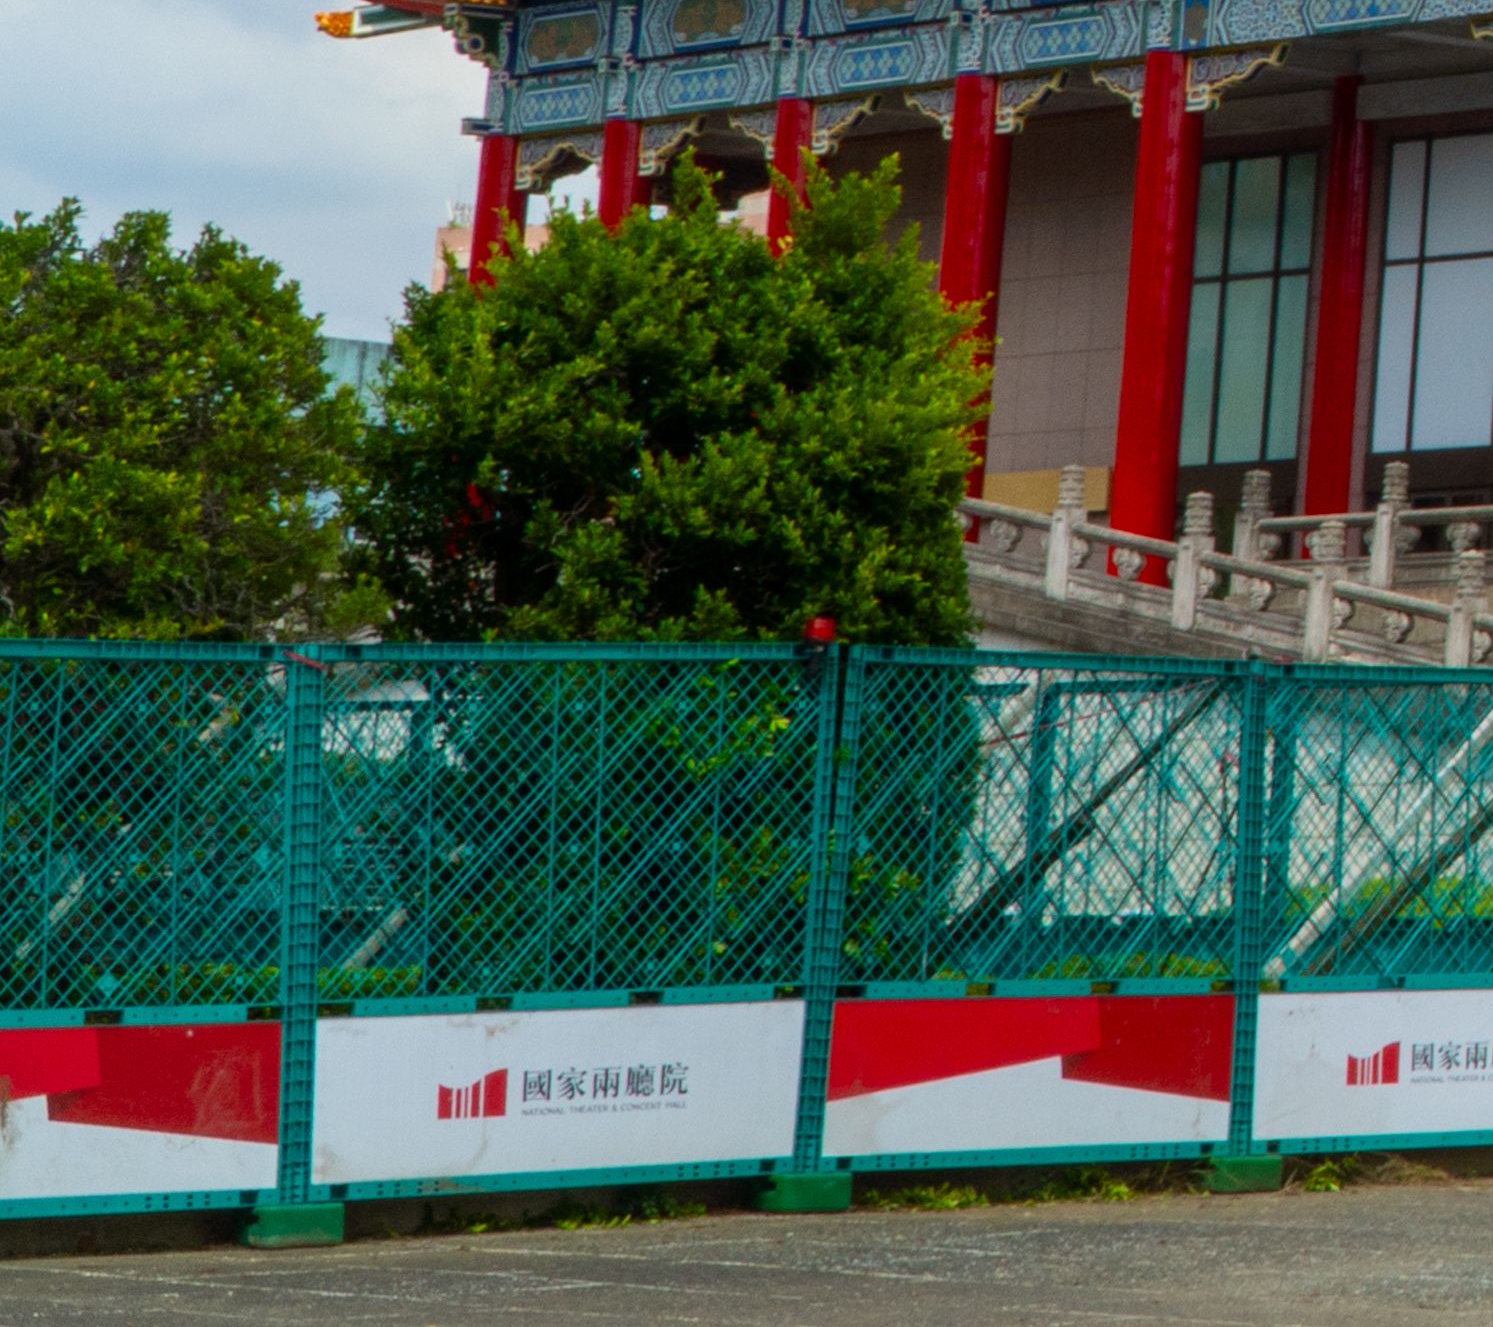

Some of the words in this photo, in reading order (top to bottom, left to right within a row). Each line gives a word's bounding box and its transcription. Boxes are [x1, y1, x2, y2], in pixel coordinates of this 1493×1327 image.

[522, 1062, 690, 1102] 國家兩廳院
[521, 1107, 564, 1116] NATIONAL
[569, 1104, 608, 1115] THEATER
[620, 1101, 661, 1112] CONCERT
[665, 1100, 687, 1110] HALL
